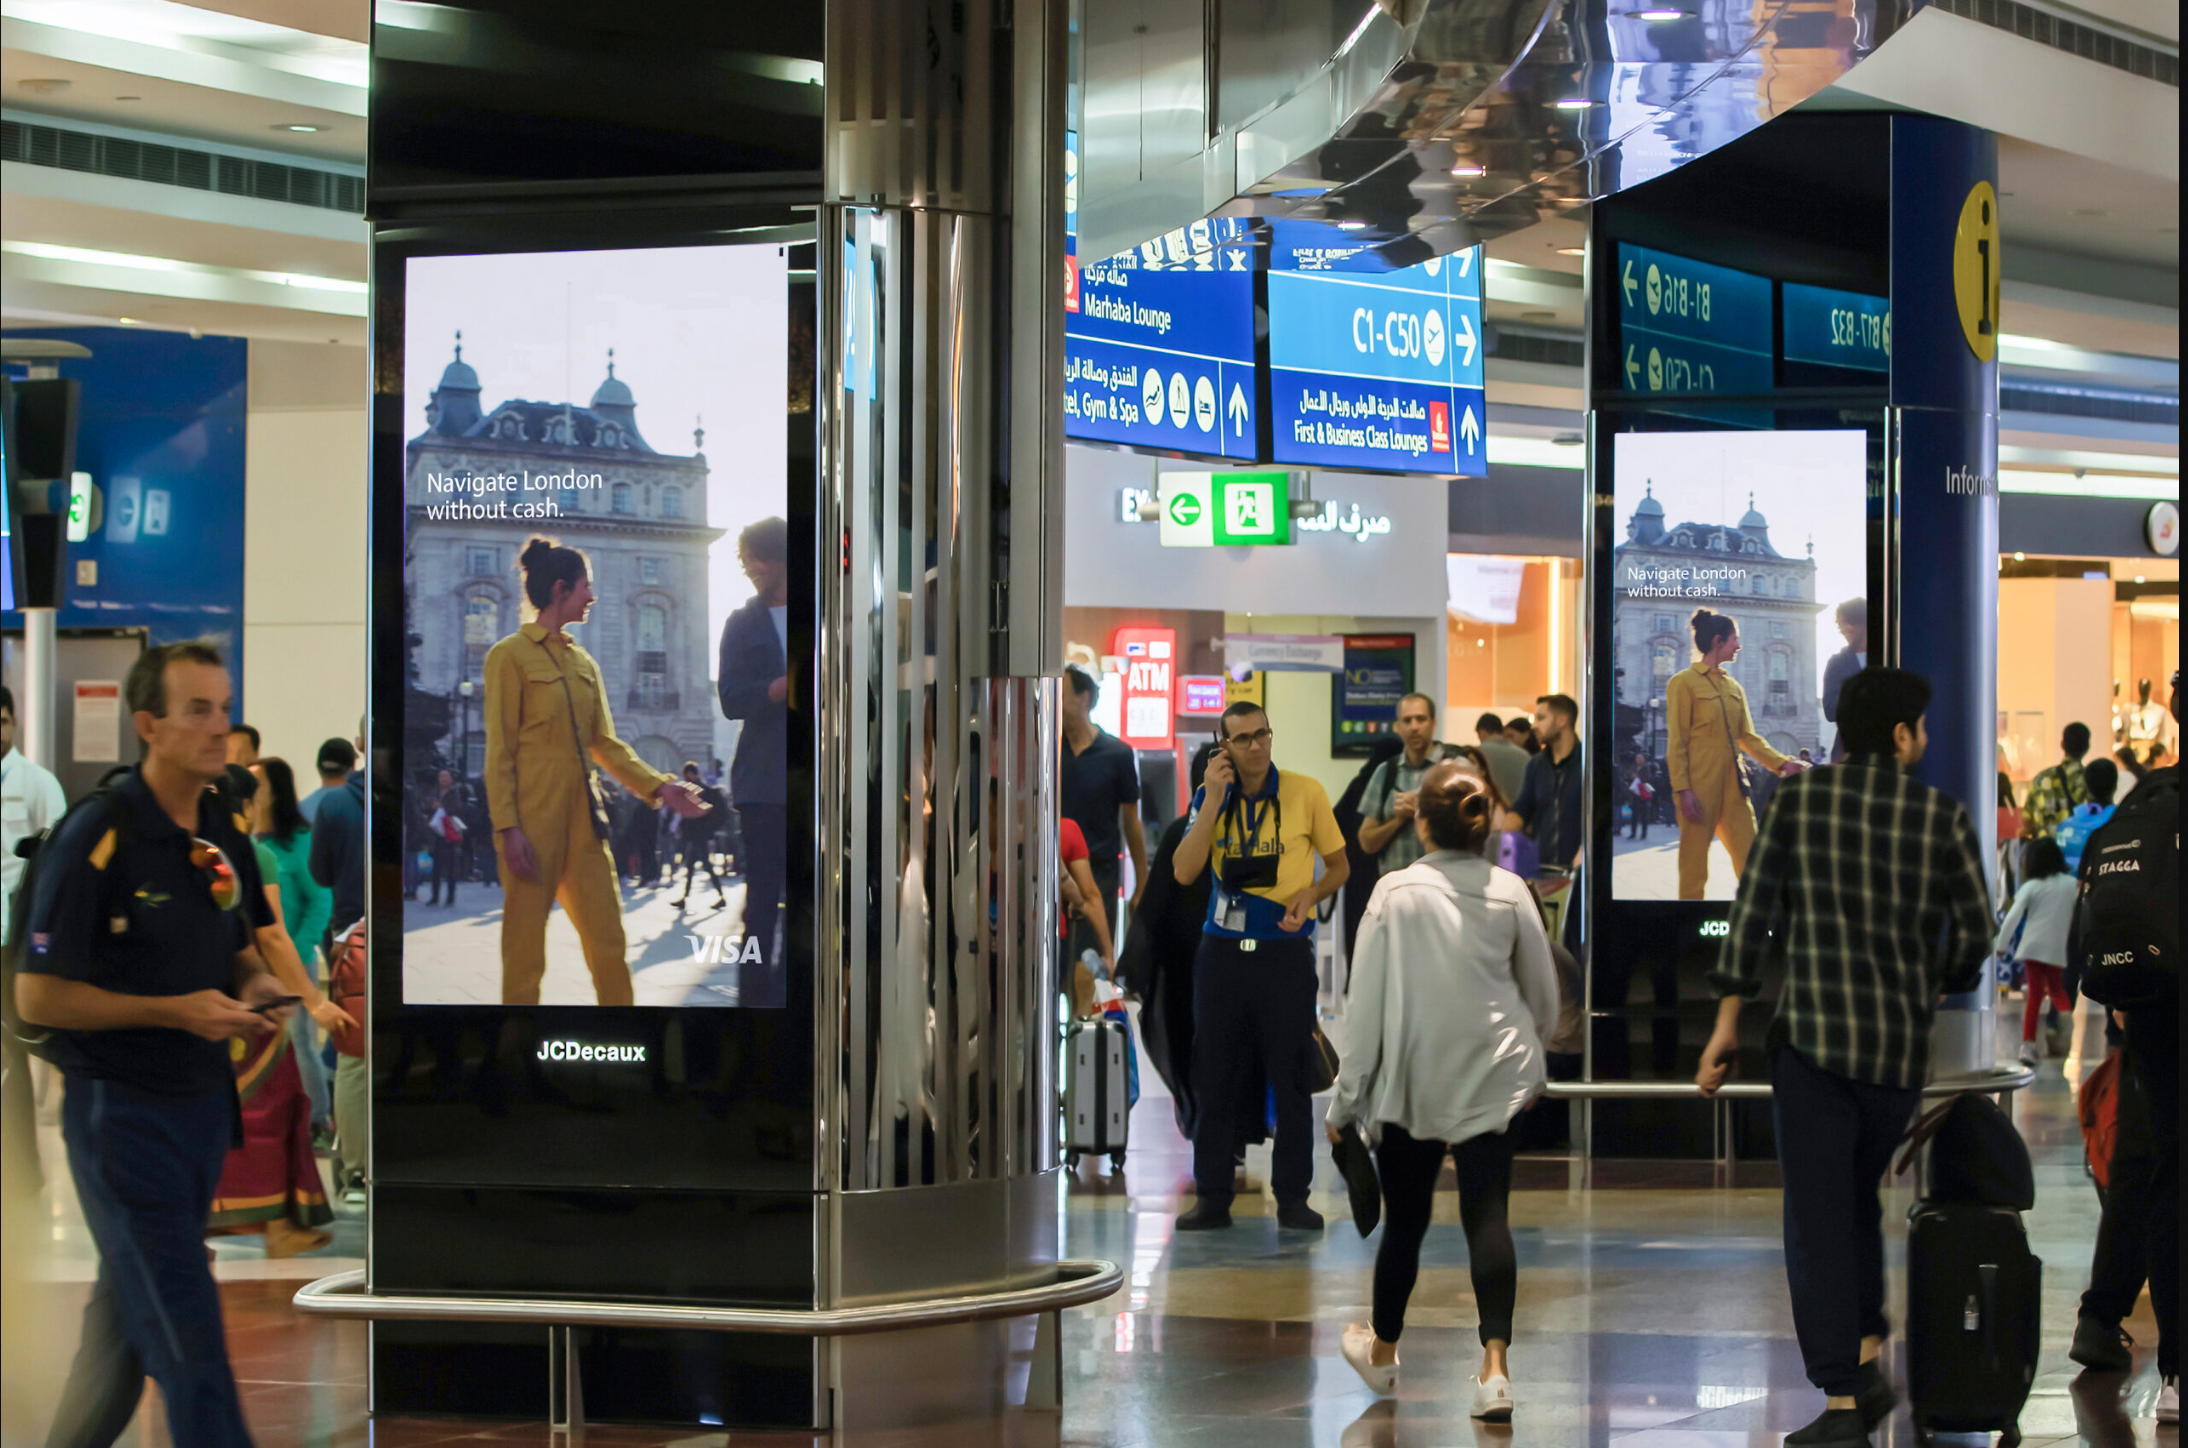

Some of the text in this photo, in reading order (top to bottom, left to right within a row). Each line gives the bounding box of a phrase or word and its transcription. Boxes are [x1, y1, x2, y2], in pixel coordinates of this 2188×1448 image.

[1084, 292, 1172, 335] Marhaba Lounge
[1352, 307, 1421, 359] C1-C50
[1081, 358, 1109, 388] وصالة
[1110, 365, 1138, 392] الفندق
[1082, 392, 1107, 424] Gym
[1109, 395, 1118, 420] &
[1119, 397, 1139, 428] Spa
[1328, 391, 1350, 418] ورجال
[1400, 399, 1426, 420] صالات
[1294, 419, 1428, 457] First & Business Class Lounges
[427, 468, 603, 497] Navigate London
[427, 496, 565, 520] without cash.
[1339, 502, 1391, 542] صرف
[1628, 565, 1747, 583] Navigate London
[1628, 583, 1721, 597] without cash.
[1127, 662, 1170, 691] ATM
[2099, 859, 2140, 876] STAGGA
[1699, 921, 1730, 936] JCD
[683, 935, 763, 964] VISA
[2101, 951, 2134, 966] JNCC
[537, 1040, 646, 1062] JCDecaux
